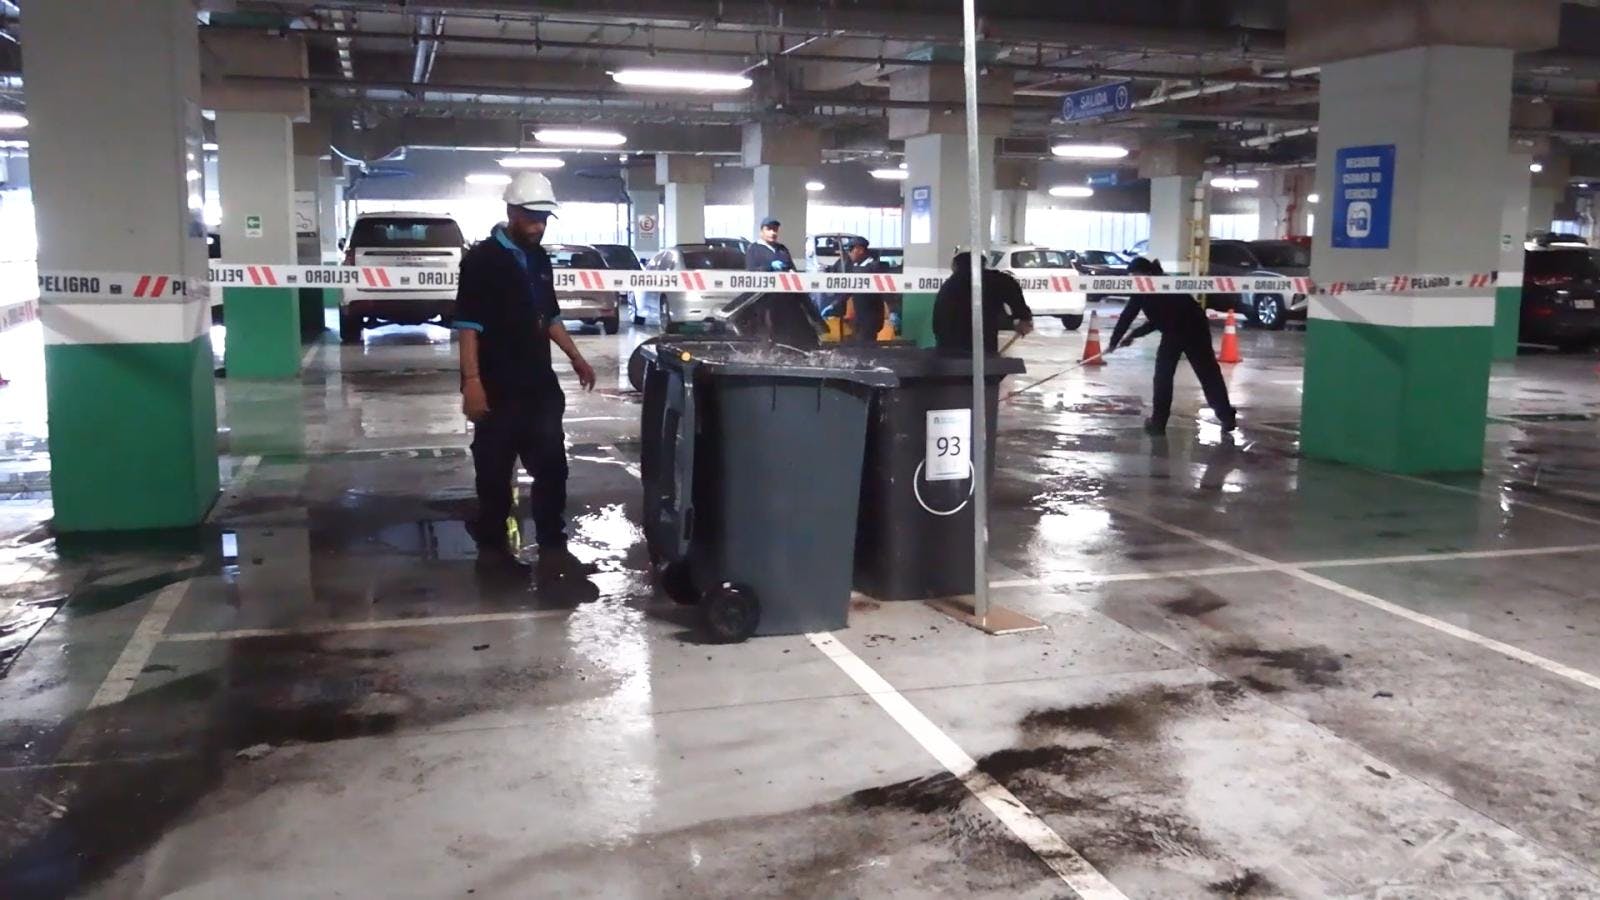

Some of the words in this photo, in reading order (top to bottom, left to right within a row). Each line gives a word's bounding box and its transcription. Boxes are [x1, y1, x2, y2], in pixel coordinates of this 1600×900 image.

[1080, 91, 1108, 109] SALIDA
[38, 275, 100, 293] PELIGRO
[936, 436, 961, 458] 93
